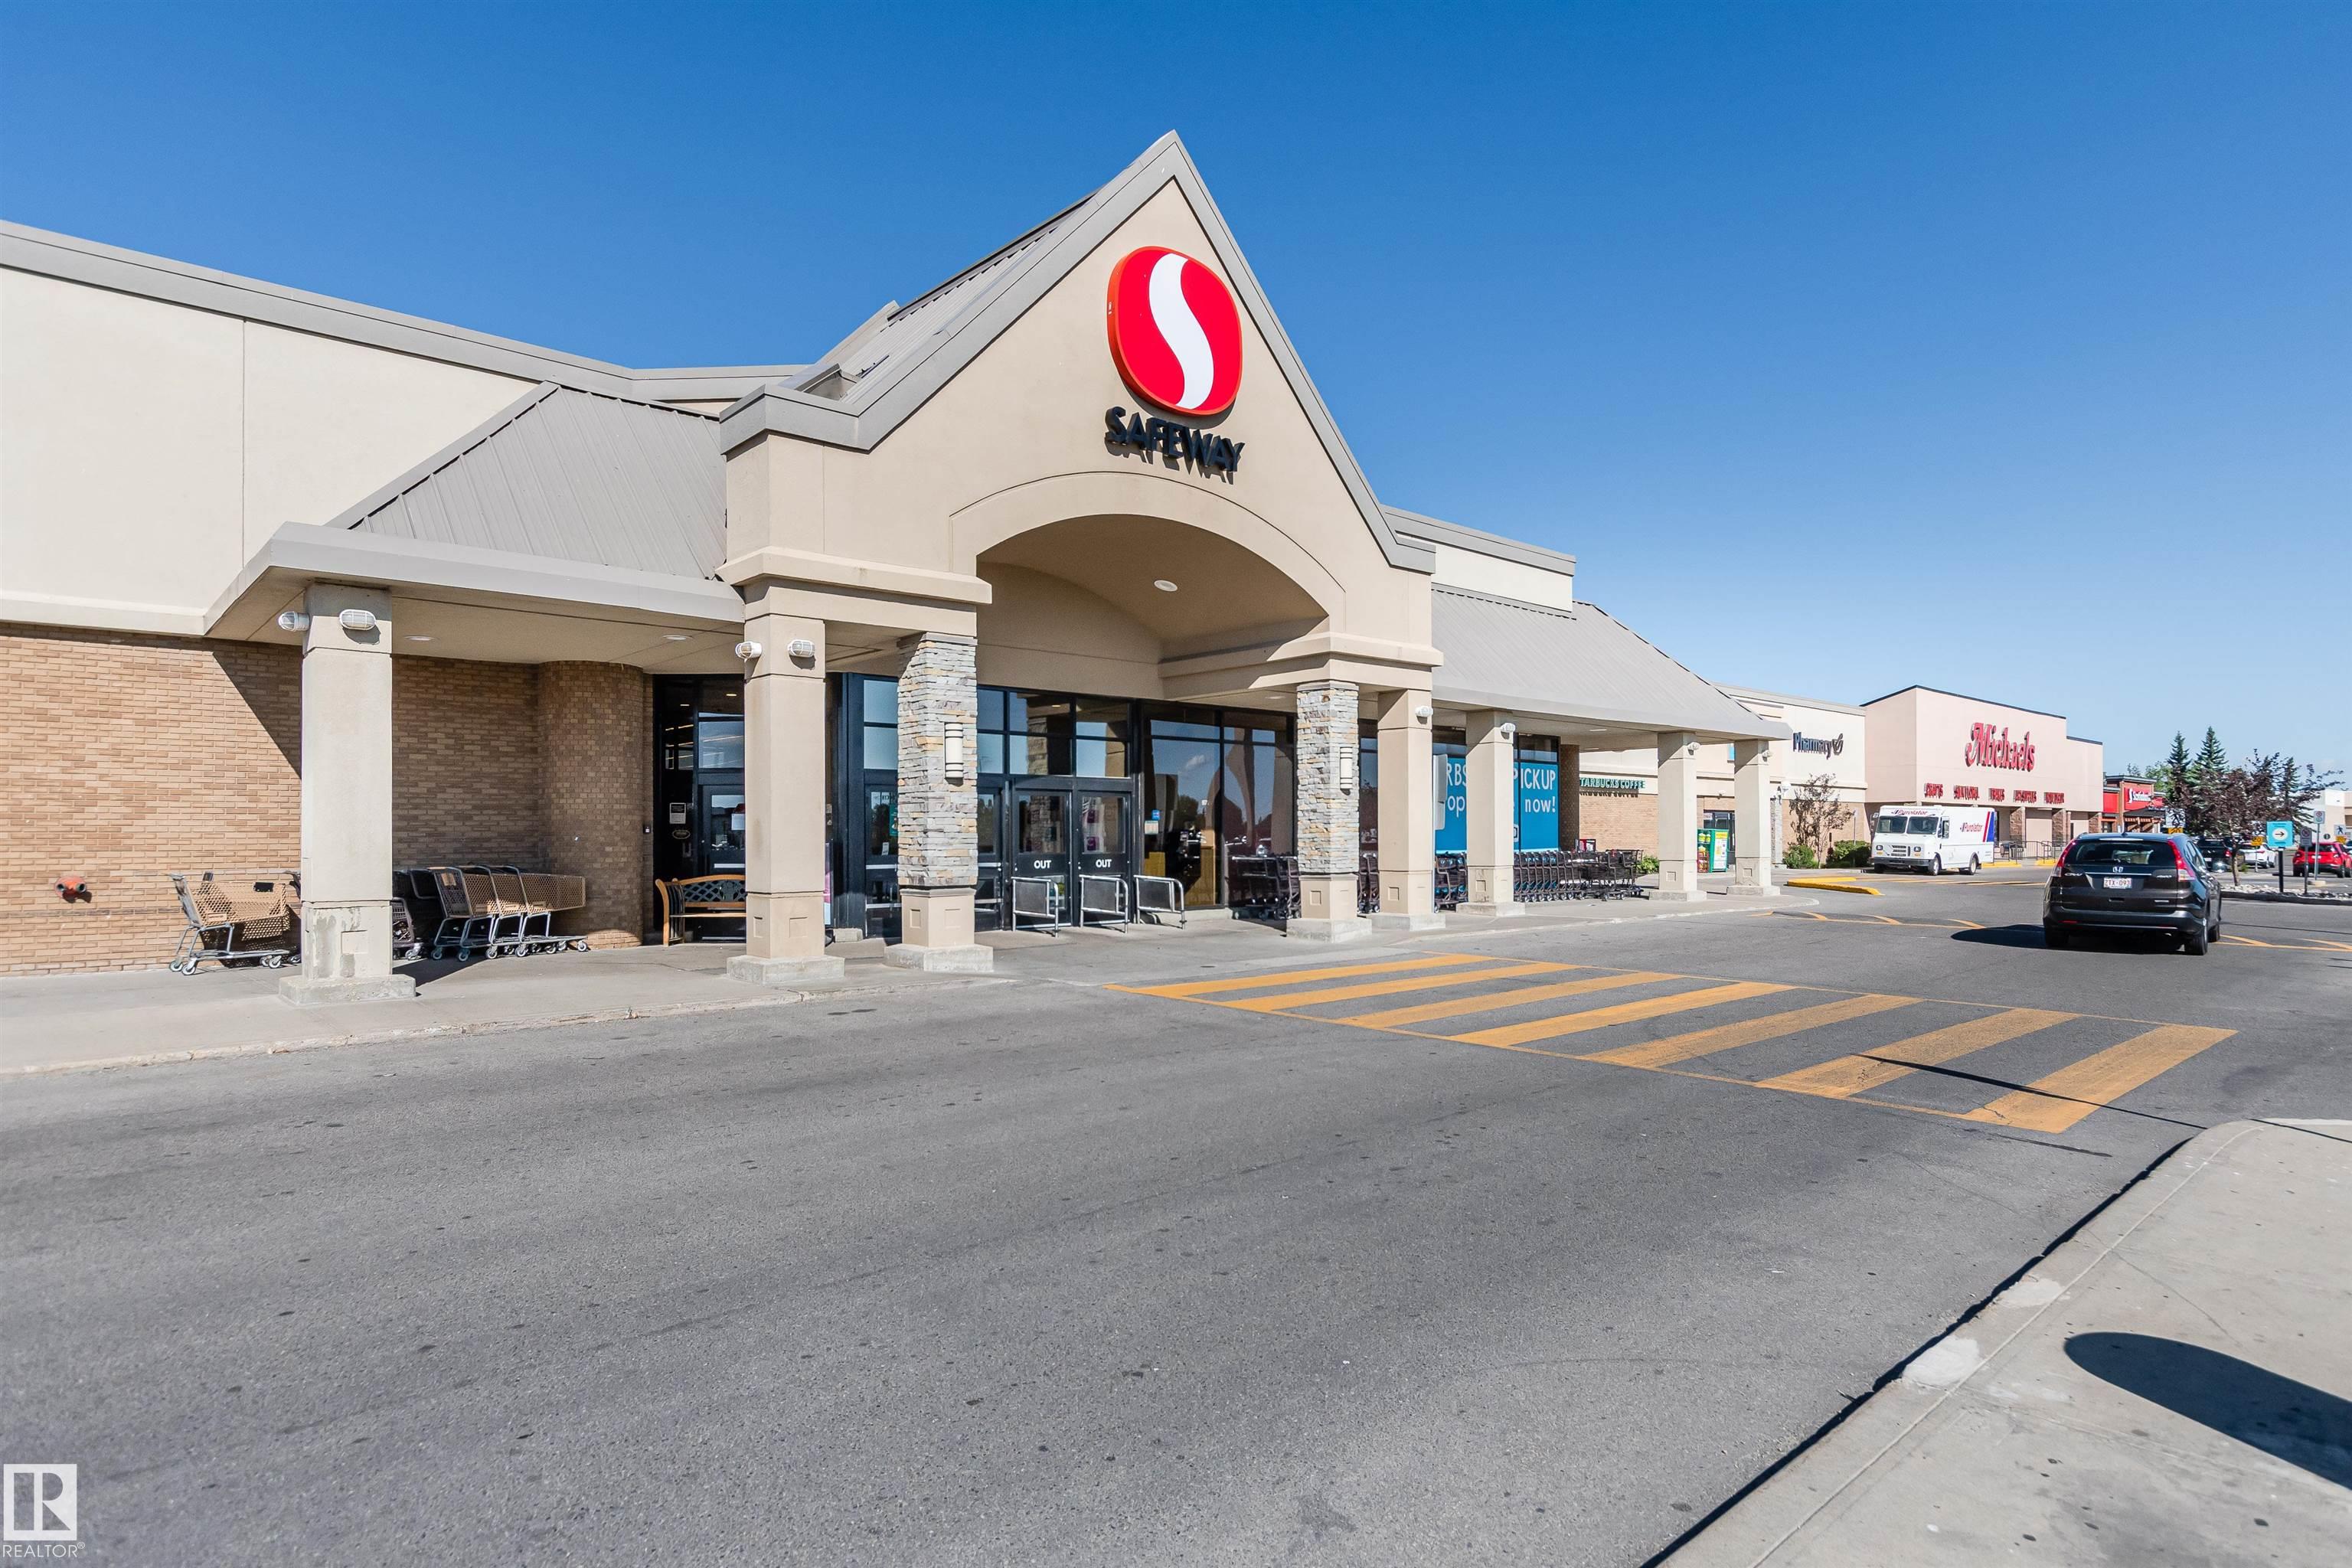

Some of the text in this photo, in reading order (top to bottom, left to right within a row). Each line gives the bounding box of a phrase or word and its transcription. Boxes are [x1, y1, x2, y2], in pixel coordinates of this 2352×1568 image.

[1105, 407, 1245, 472] SAFEWAY
[1793, 732, 1832, 760] Pharmacy
[1965, 723, 2035, 772] Michaels
[1579, 777, 1645, 789] TARBUCKS COFFEE
[1448, 795, 1556, 818] op now!
[1034, 860, 1051, 869] OUT
[1096, 859, 1112, 868] OUT
